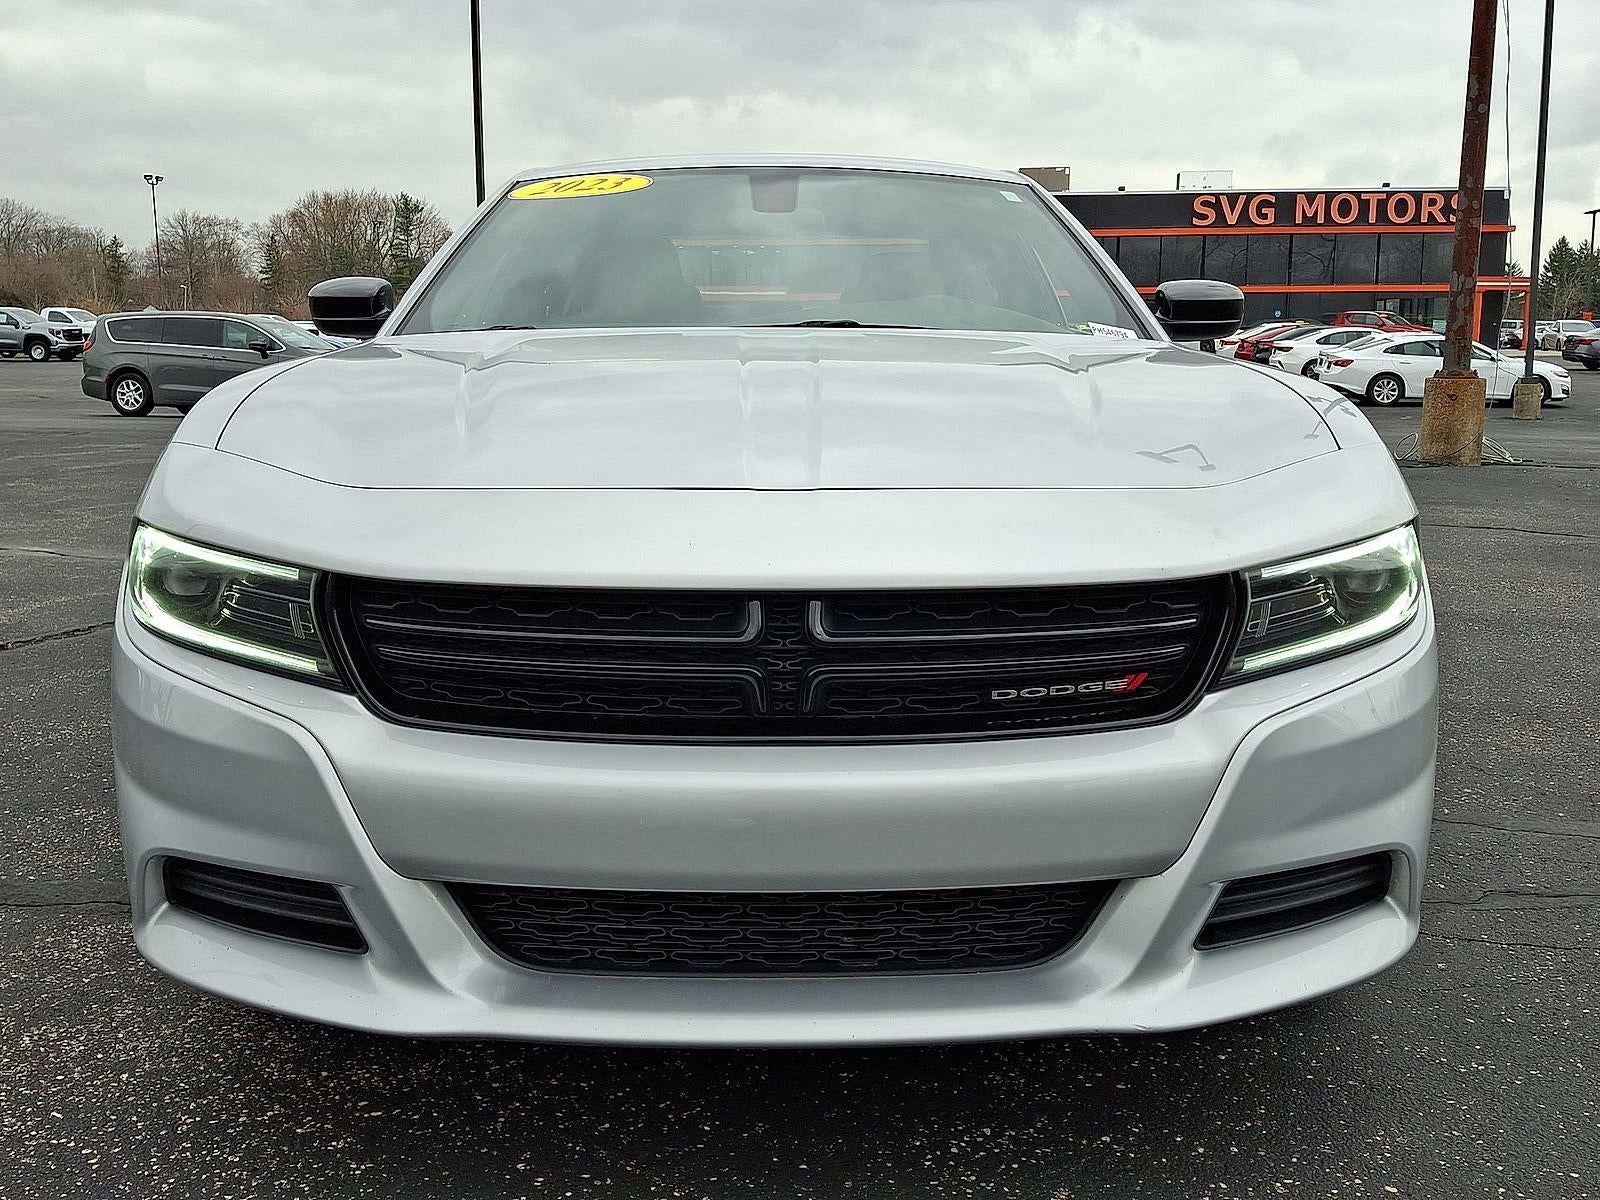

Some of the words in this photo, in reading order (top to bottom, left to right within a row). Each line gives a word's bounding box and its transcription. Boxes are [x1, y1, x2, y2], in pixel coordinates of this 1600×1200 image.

[529, 177, 632, 196] 2023
[1192, 193, 1276, 226] SVG
[991, 678, 1129, 700] DODGE
